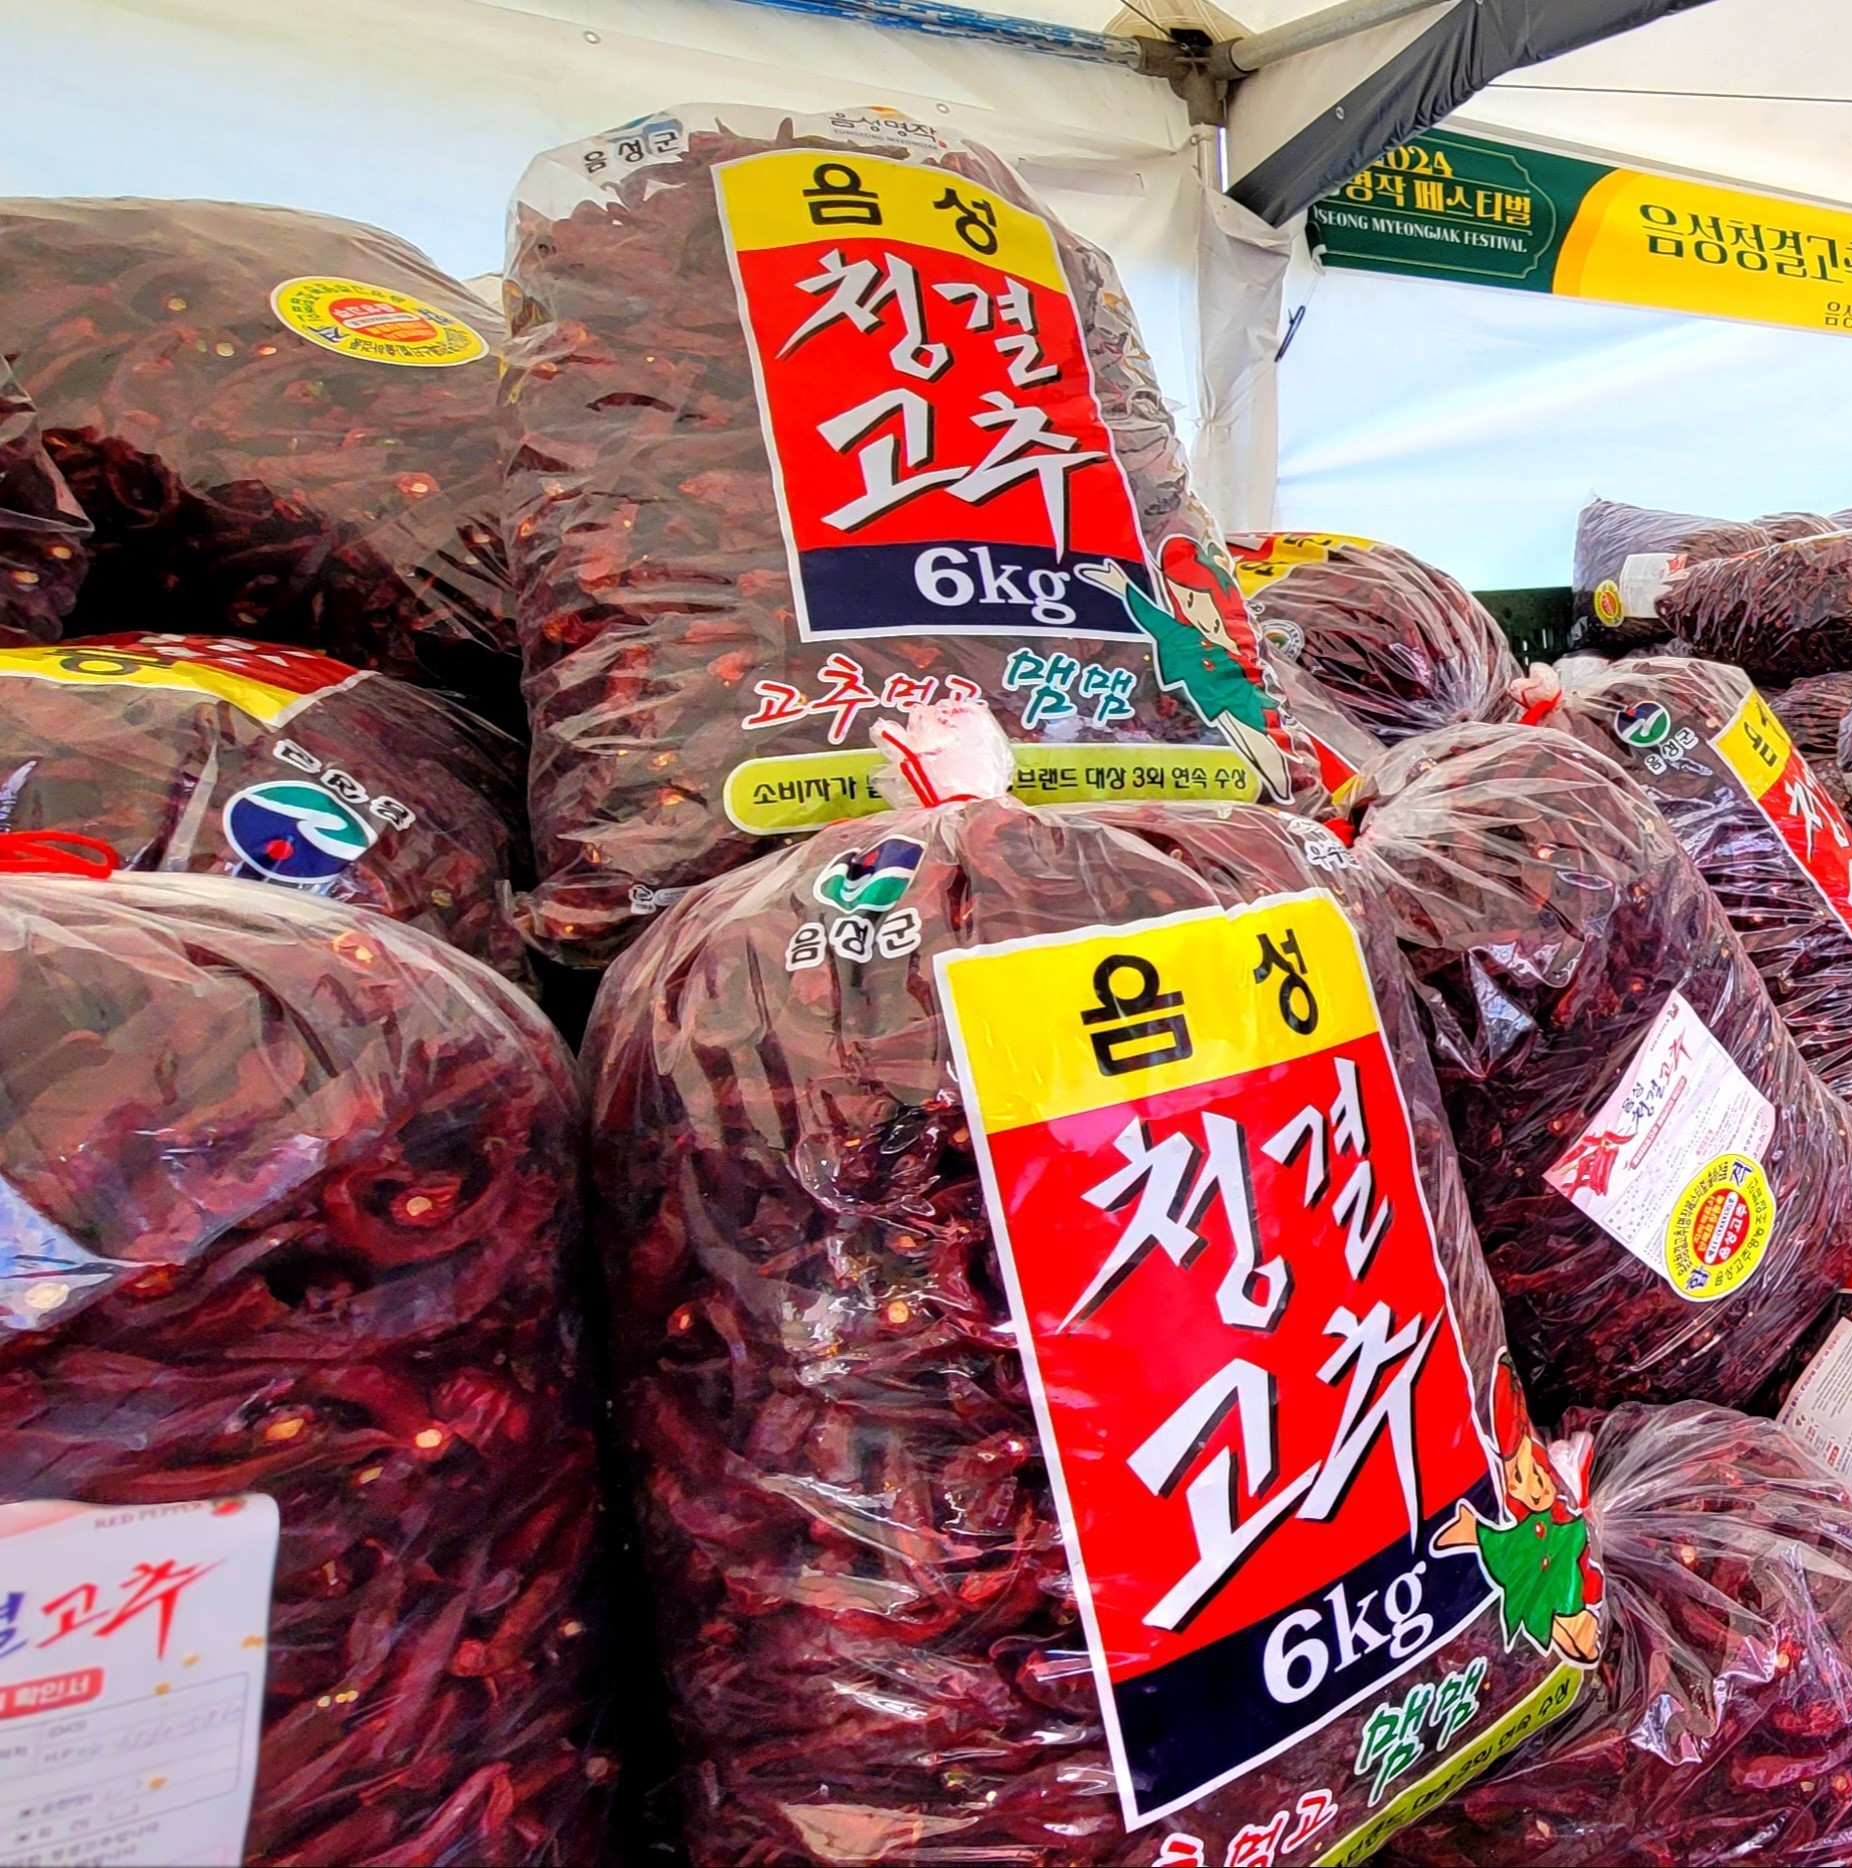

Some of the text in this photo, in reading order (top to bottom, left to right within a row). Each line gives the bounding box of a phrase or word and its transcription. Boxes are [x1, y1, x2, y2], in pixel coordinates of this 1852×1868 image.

[584, 131, 680, 173] 음성군
[828, 112, 938, 143] 음성명작
[1338, 169, 1532, 227] 명작 페스티벌
[1372, 217, 1460, 244] MYEONGJAK
[1463, 230, 1527, 252] FESTIVAL
[775, 247, 1060, 386] 청결
[816, 388, 1108, 565] 고추
[912, 547, 1076, 626] 6kg
[1644, 727, 1697, 775] 음성군
[753, 774, 860, 807] 소비자가
[1016, 766, 1080, 792] 브랜드
[1086, 767, 1127, 792] 대상
[1132, 767, 1166, 791] 3회
[1170, 767, 1208, 792] 연속
[1213, 767, 1248, 791] 수상
[787, 910, 921, 969] 음성군
[1055, 1057, 1396, 1335] 청결
[1126, 1299, 1446, 1633] 고추
[1259, 1547, 1434, 1706] 6kg
